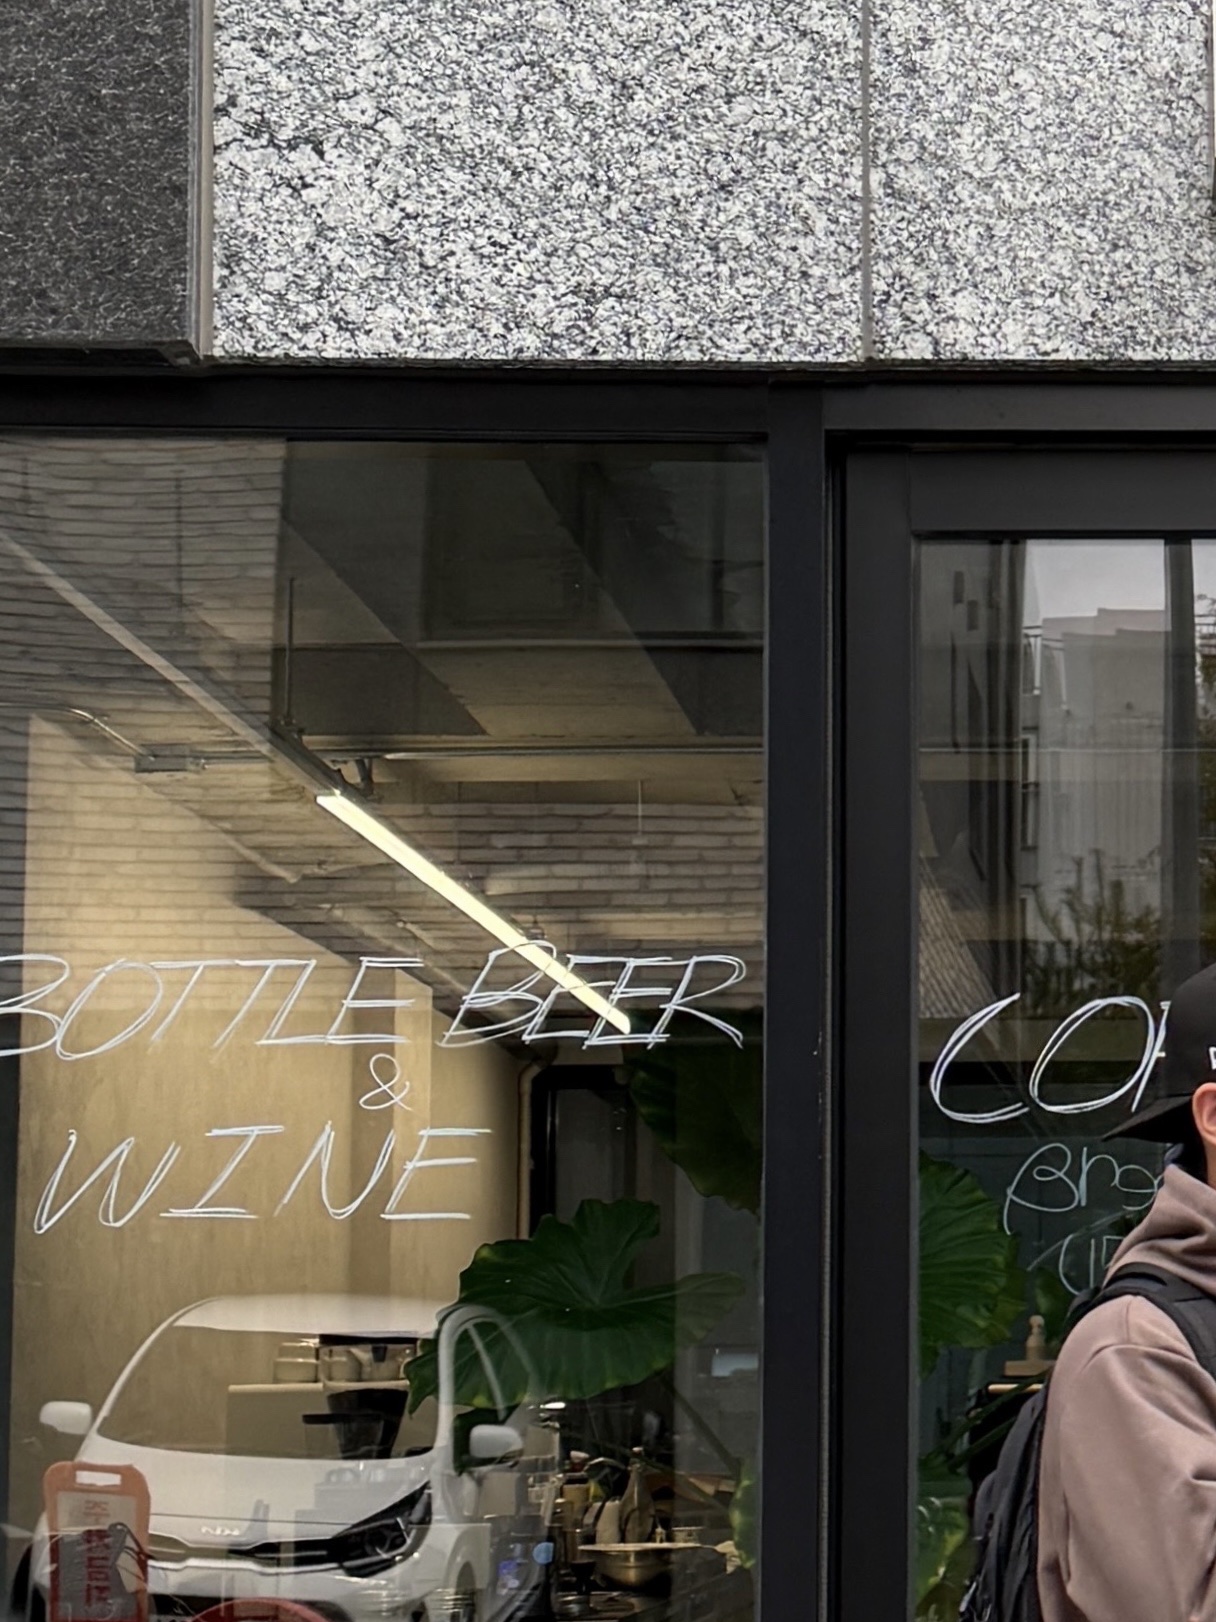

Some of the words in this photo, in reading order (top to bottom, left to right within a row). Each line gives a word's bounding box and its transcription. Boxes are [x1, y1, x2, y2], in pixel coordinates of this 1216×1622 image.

[0, 953, 424, 1061] BOTTLE
[436, 940, 747, 1050] BEER
[358, 1053, 413, 1111] &
[33, 1121, 492, 1234] WINE
